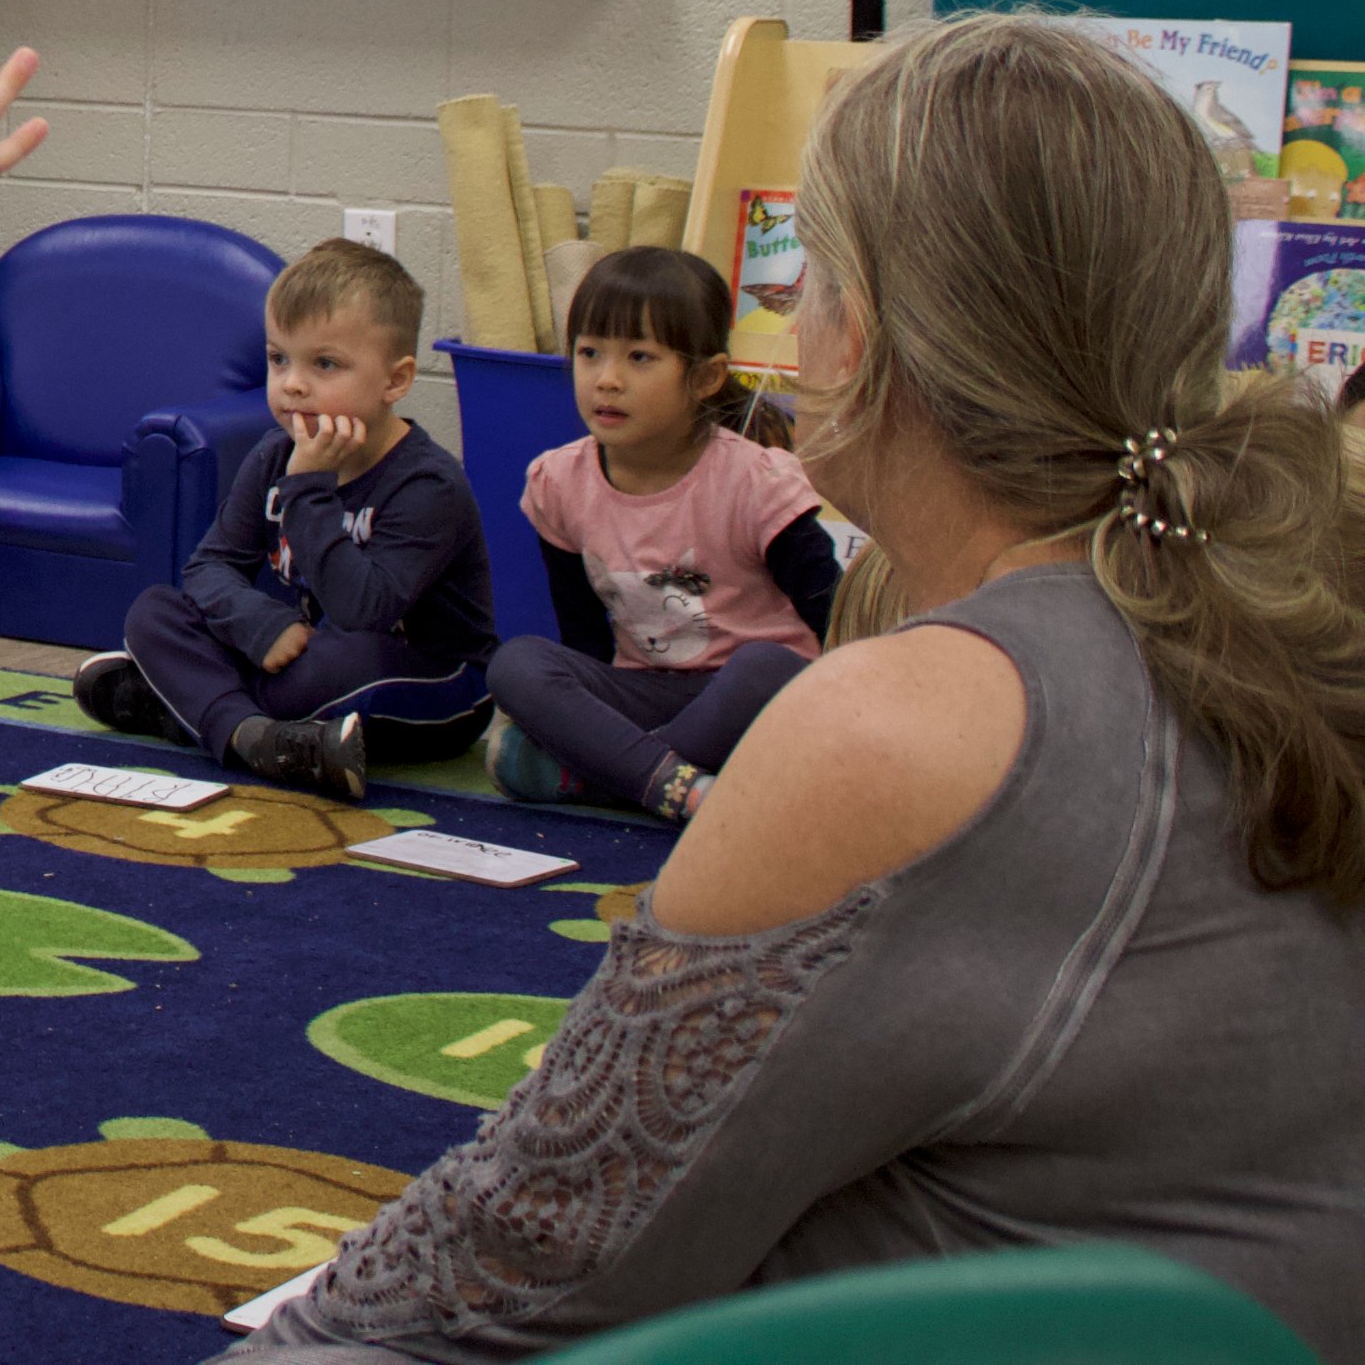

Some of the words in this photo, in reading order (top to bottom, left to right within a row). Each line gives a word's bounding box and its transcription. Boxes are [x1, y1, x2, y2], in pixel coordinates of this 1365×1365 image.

[1126, 29, 1153, 50] Be
[1159, 29, 1192, 57] My
[1197, 32, 1279, 76] Friend?
[1307, 340, 1365, 367] ERI
[100, 1182, 372, 1270] 15
